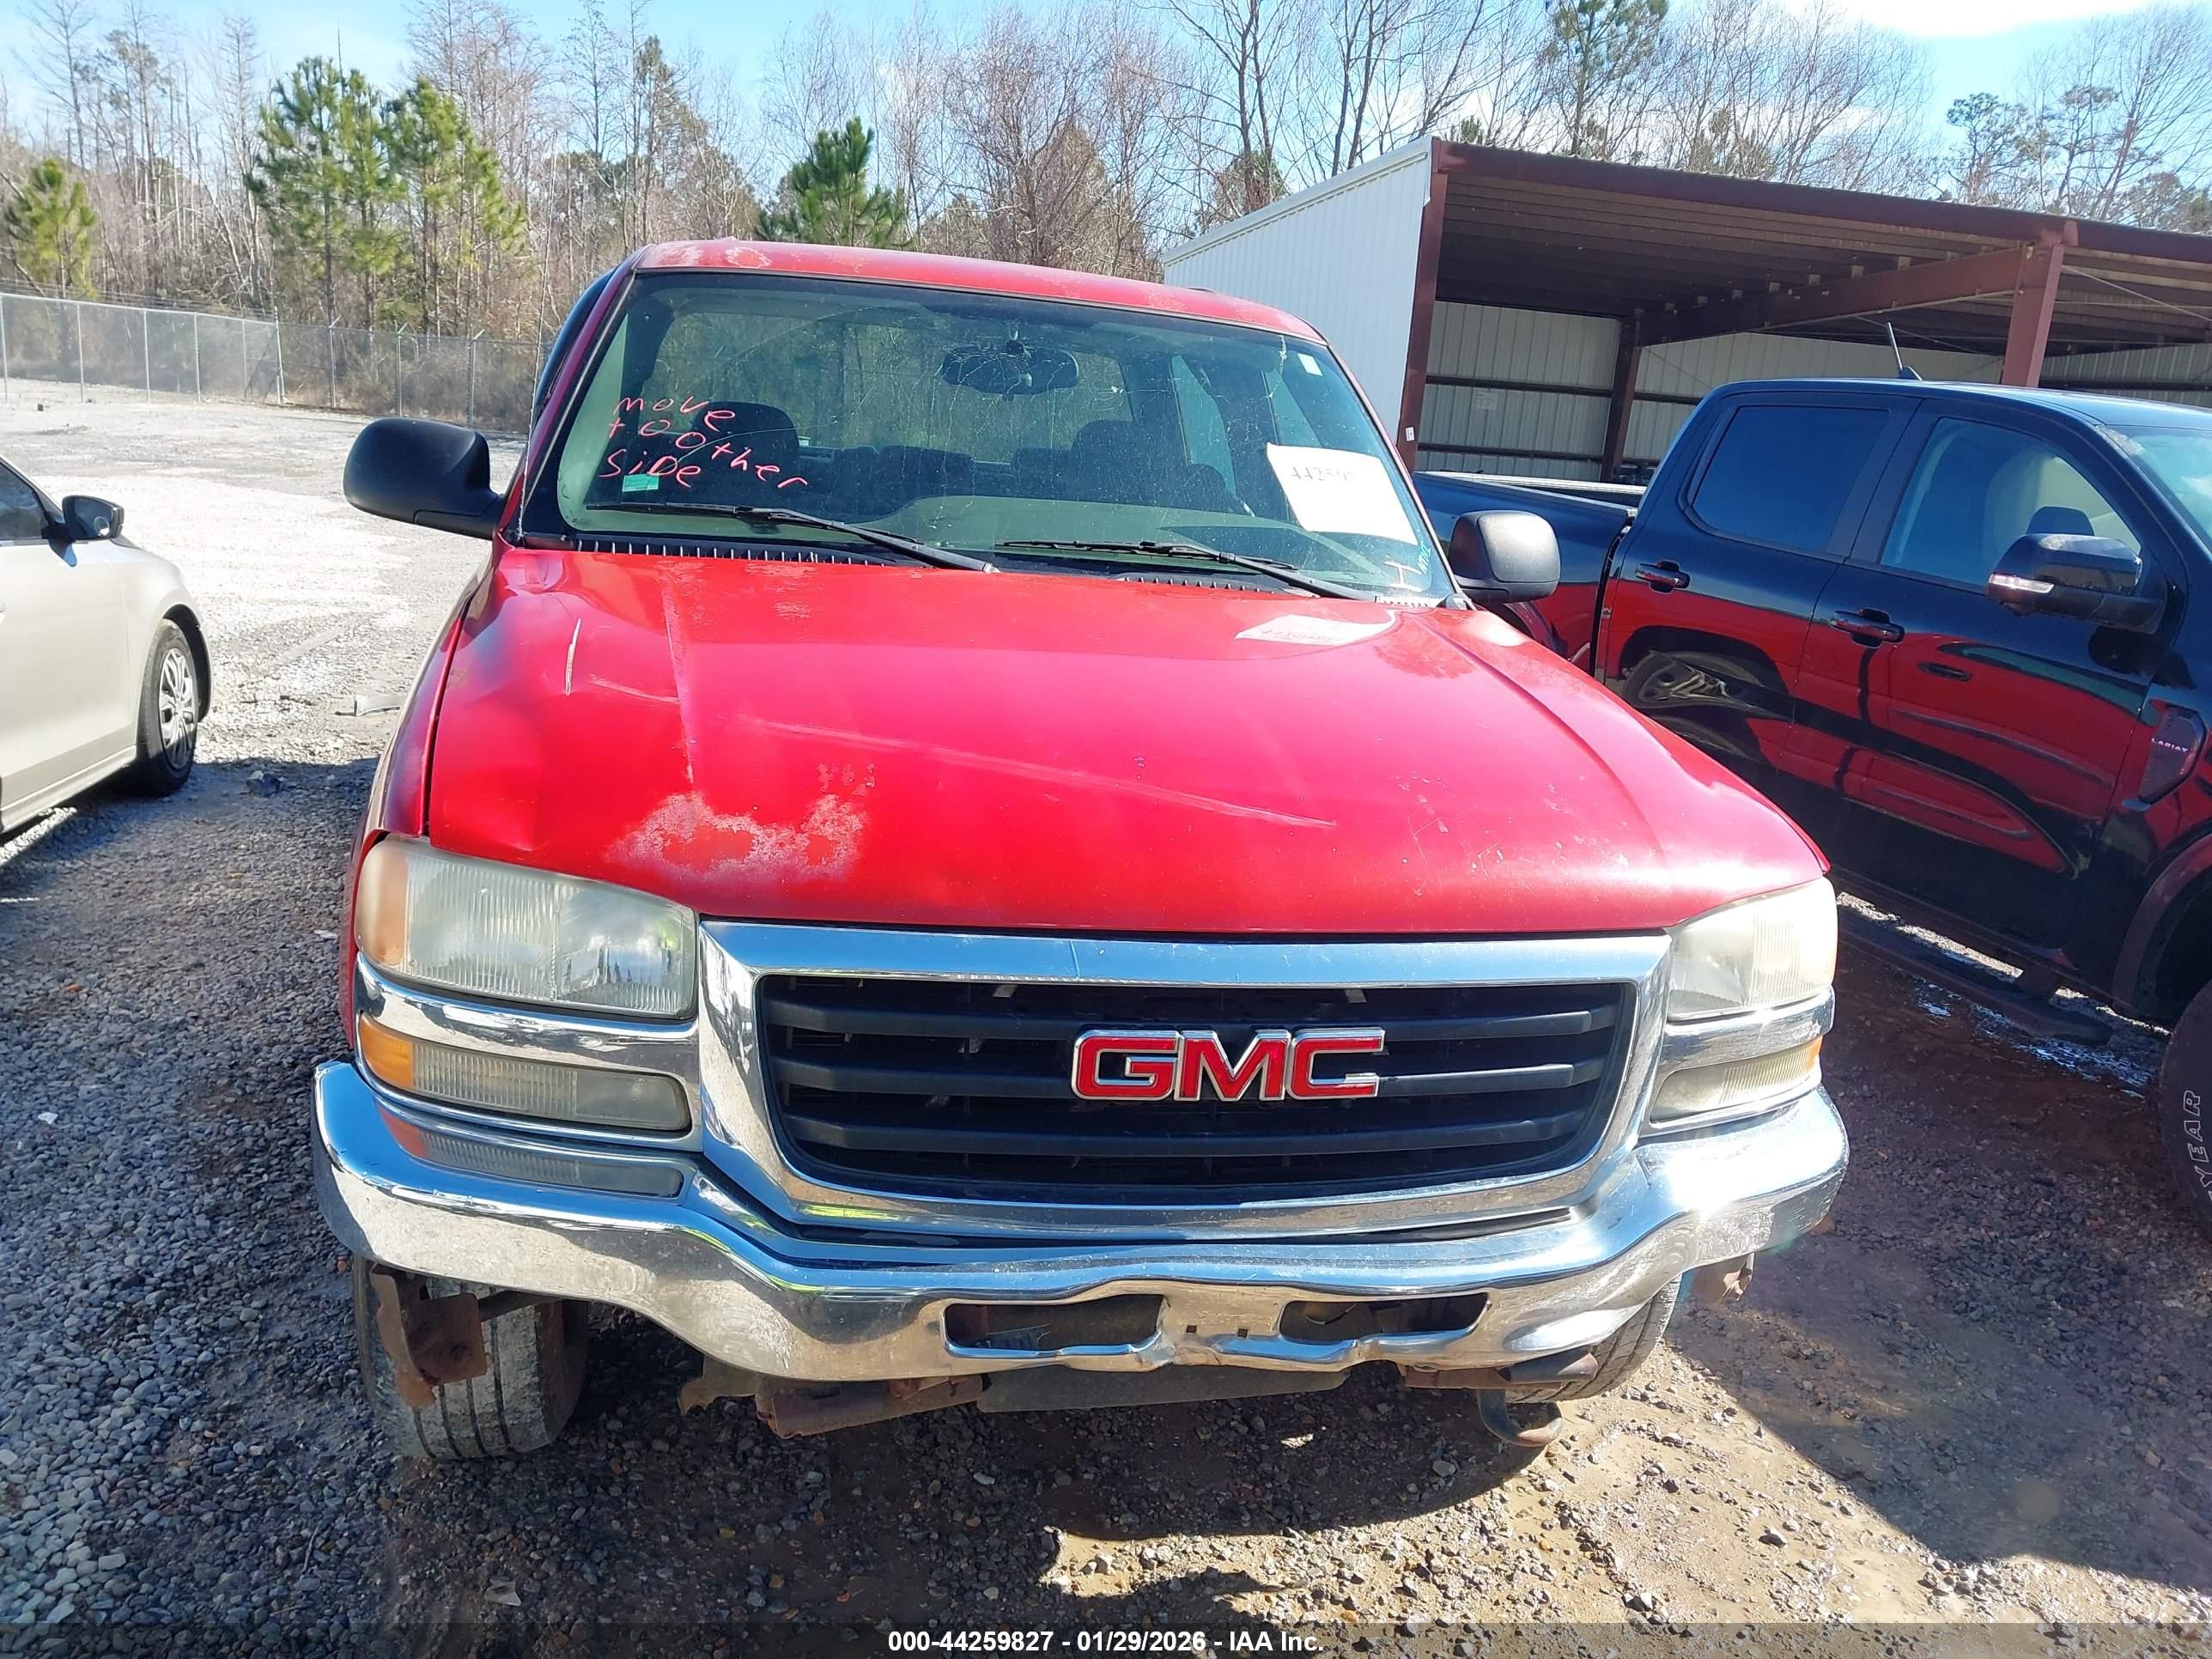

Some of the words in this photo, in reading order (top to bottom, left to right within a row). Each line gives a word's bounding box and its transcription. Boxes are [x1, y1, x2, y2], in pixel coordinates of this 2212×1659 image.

[613, 395, 736, 432] move
[2151, 738, 2189, 753] LARIAT
[1071, 1027, 1386, 1102] GMC
[2183, 1090, 2212, 1201] YEAR
